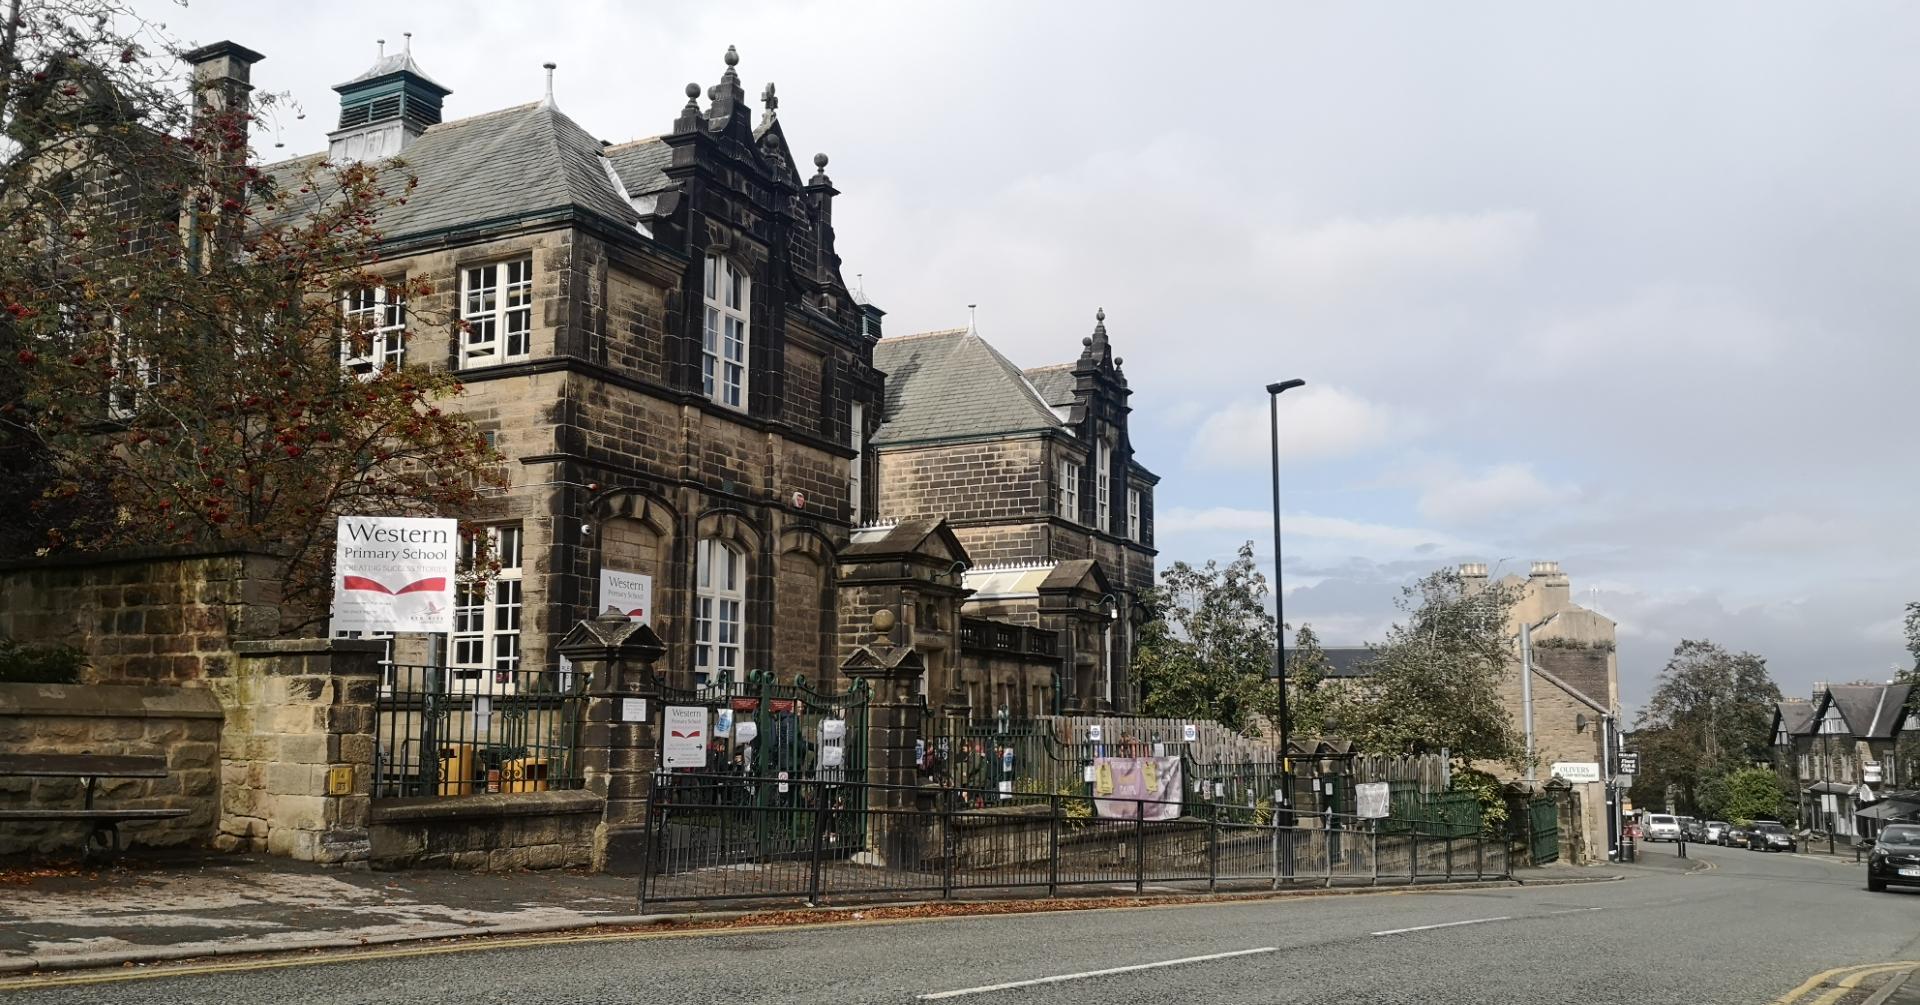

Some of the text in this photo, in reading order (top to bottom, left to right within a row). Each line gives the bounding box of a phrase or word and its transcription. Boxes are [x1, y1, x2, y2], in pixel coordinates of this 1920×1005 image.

[347, 523, 448, 544] Western
[344, 547, 447, 562] Primary School
[608, 576, 644, 591] Western
[672, 708, 702, 718] Western
